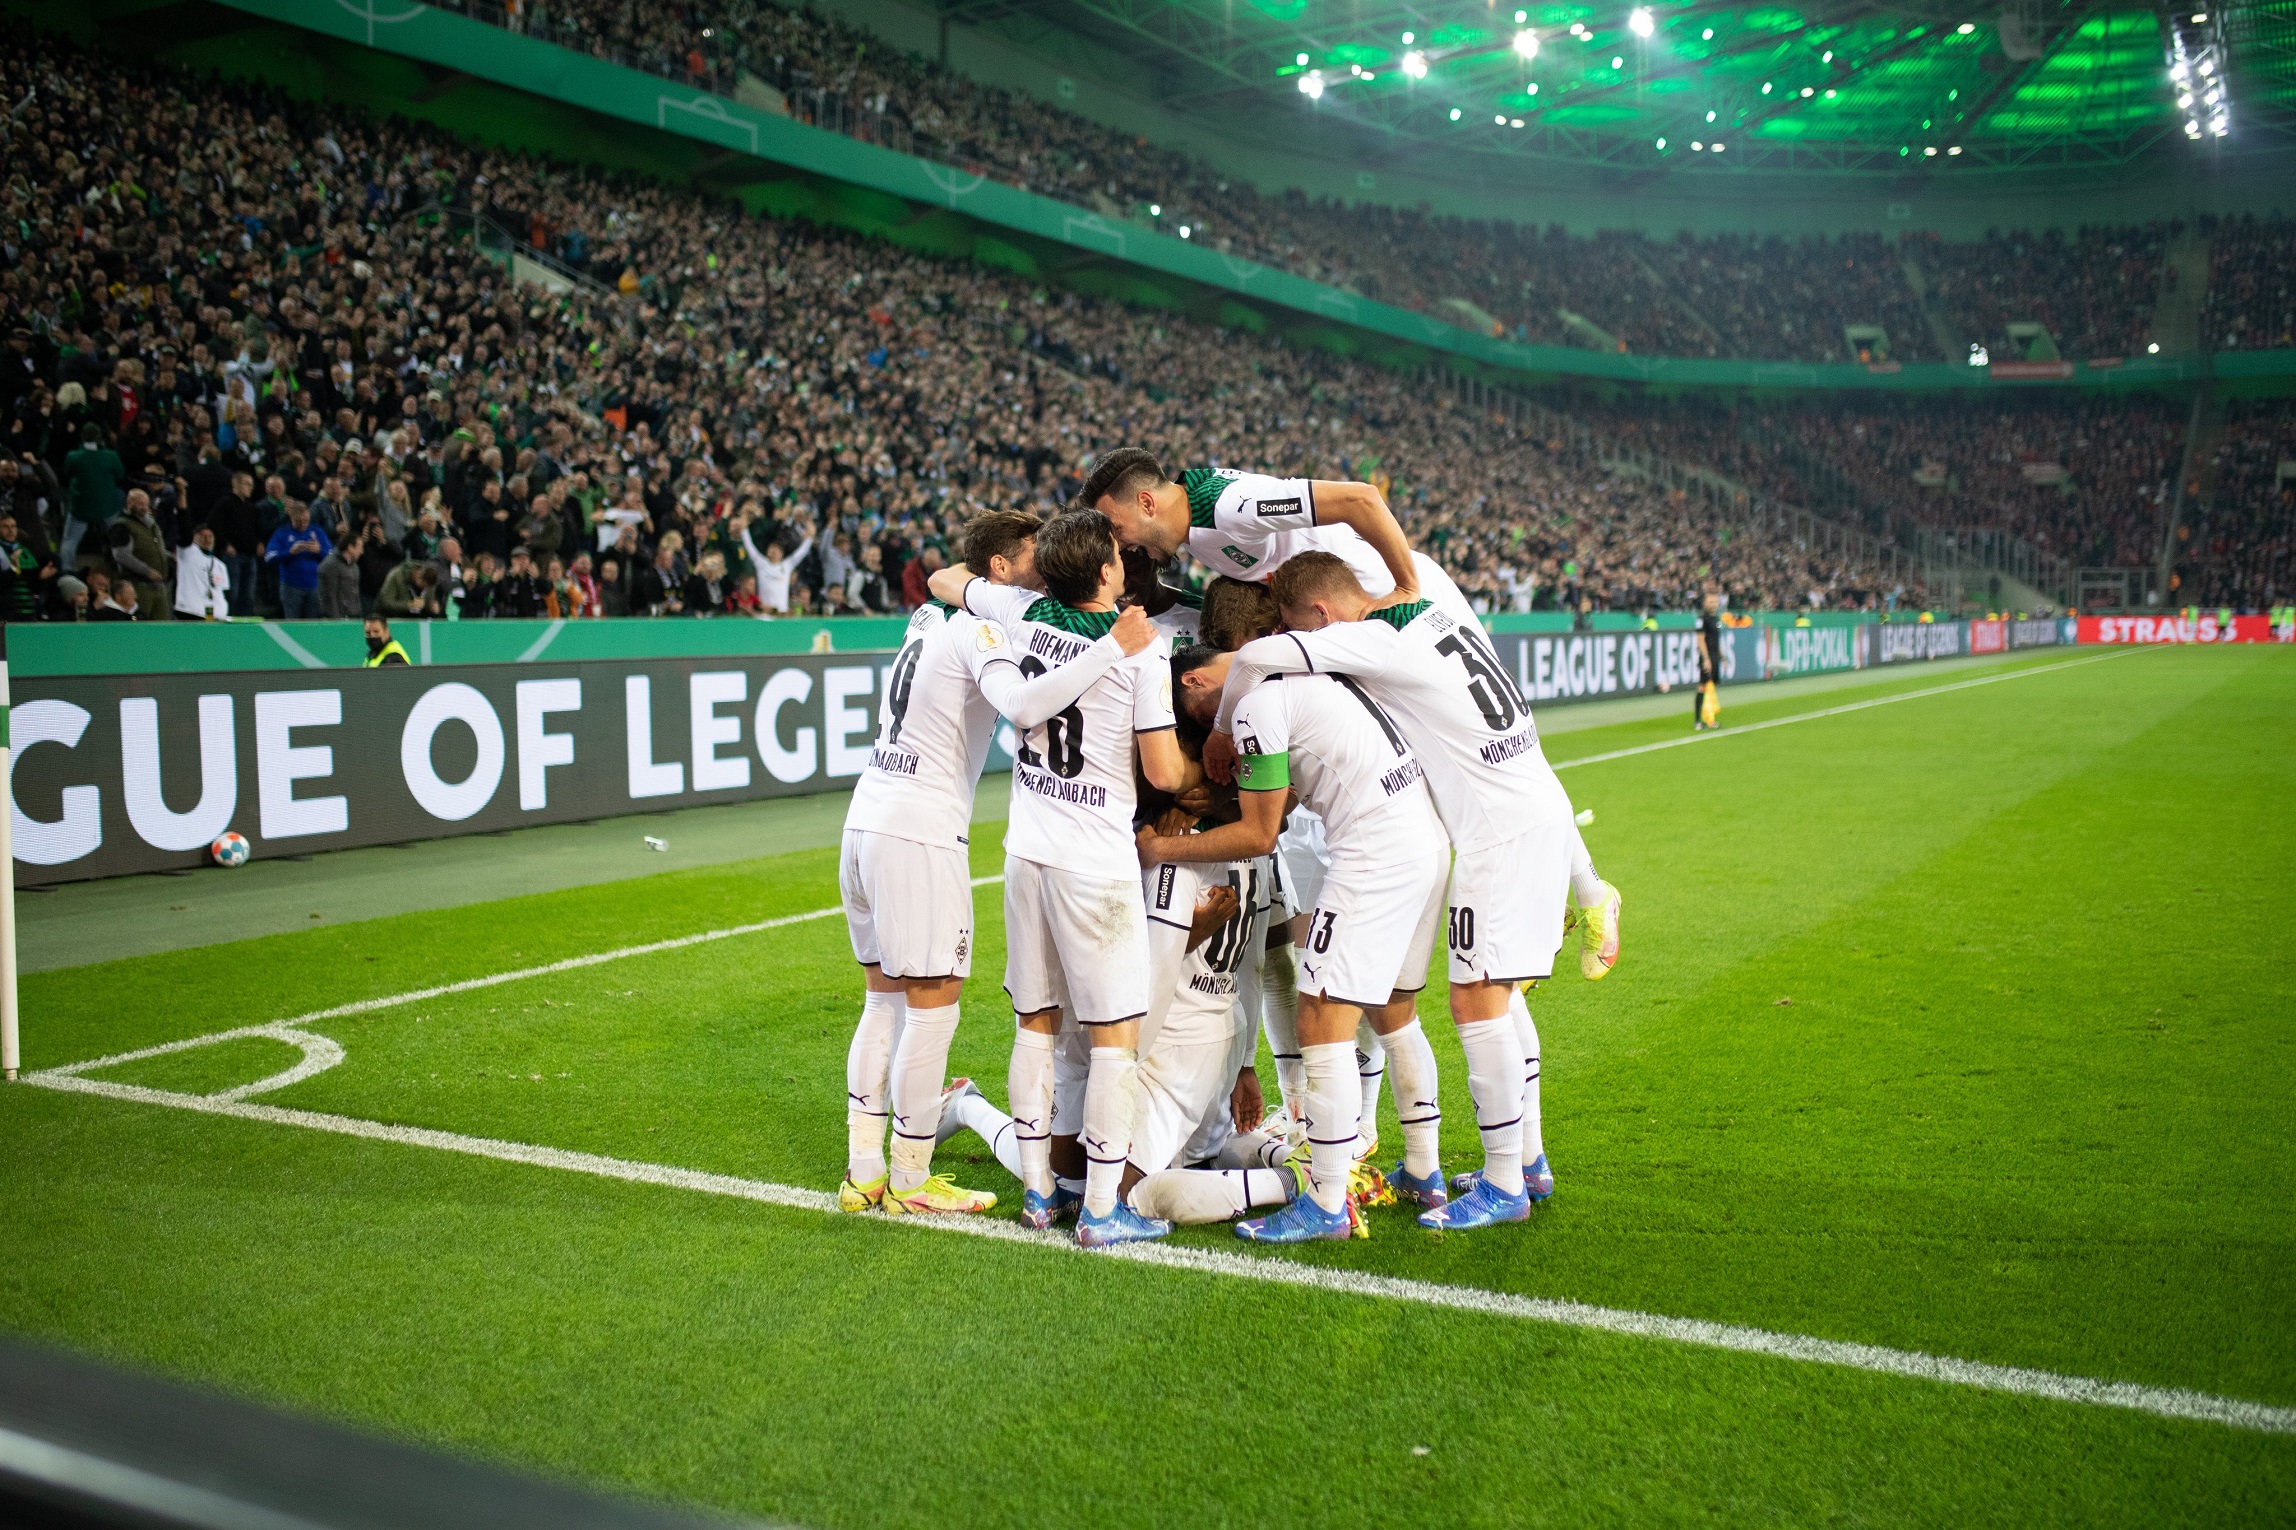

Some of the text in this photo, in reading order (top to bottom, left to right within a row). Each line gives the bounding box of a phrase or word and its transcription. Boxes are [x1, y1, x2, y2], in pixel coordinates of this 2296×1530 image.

[1260, 502, 1298, 514] Sonepar
[1518, 635, 1616, 701] LEAGUE
[1621, 634, 1652, 691] OF
[1785, 628, 1849, 672] DFB-POKAL
[1434, 625, 1530, 732] 30
[9, 666, 893, 866] GUE OF LEGE
[1159, 867, 1172, 907] Sonepar
[1306, 907, 1338, 954] 13
[1449, 906, 1475, 951] 30
